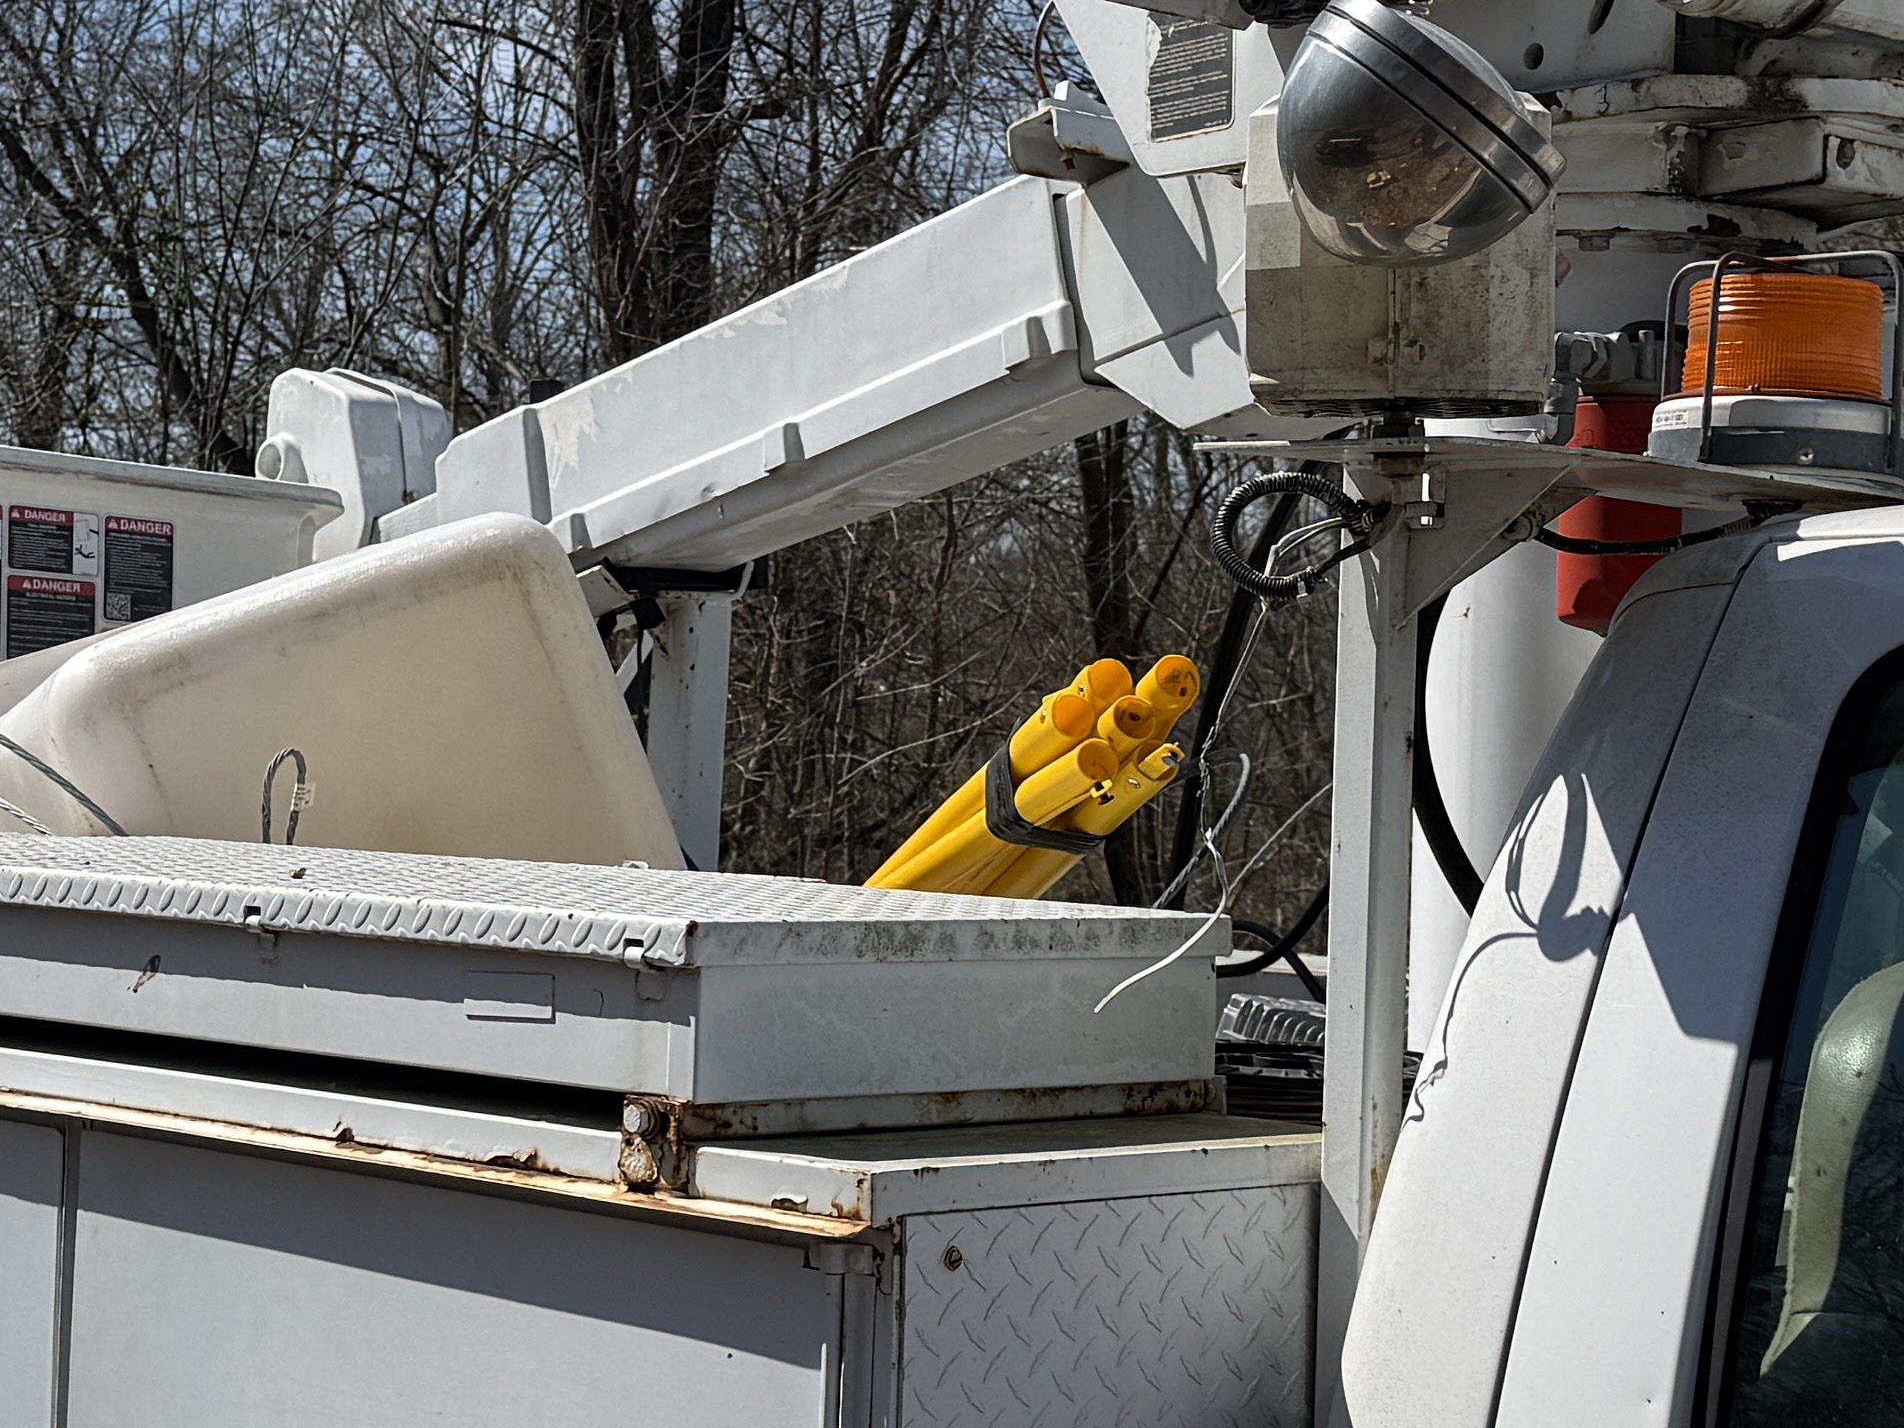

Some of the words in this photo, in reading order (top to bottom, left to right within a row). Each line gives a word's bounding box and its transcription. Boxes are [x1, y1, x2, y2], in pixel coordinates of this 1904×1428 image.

[24, 509, 66, 523] DANGER
[120, 519, 172, 535] DANGER
[32, 579, 81, 593] DANGER
